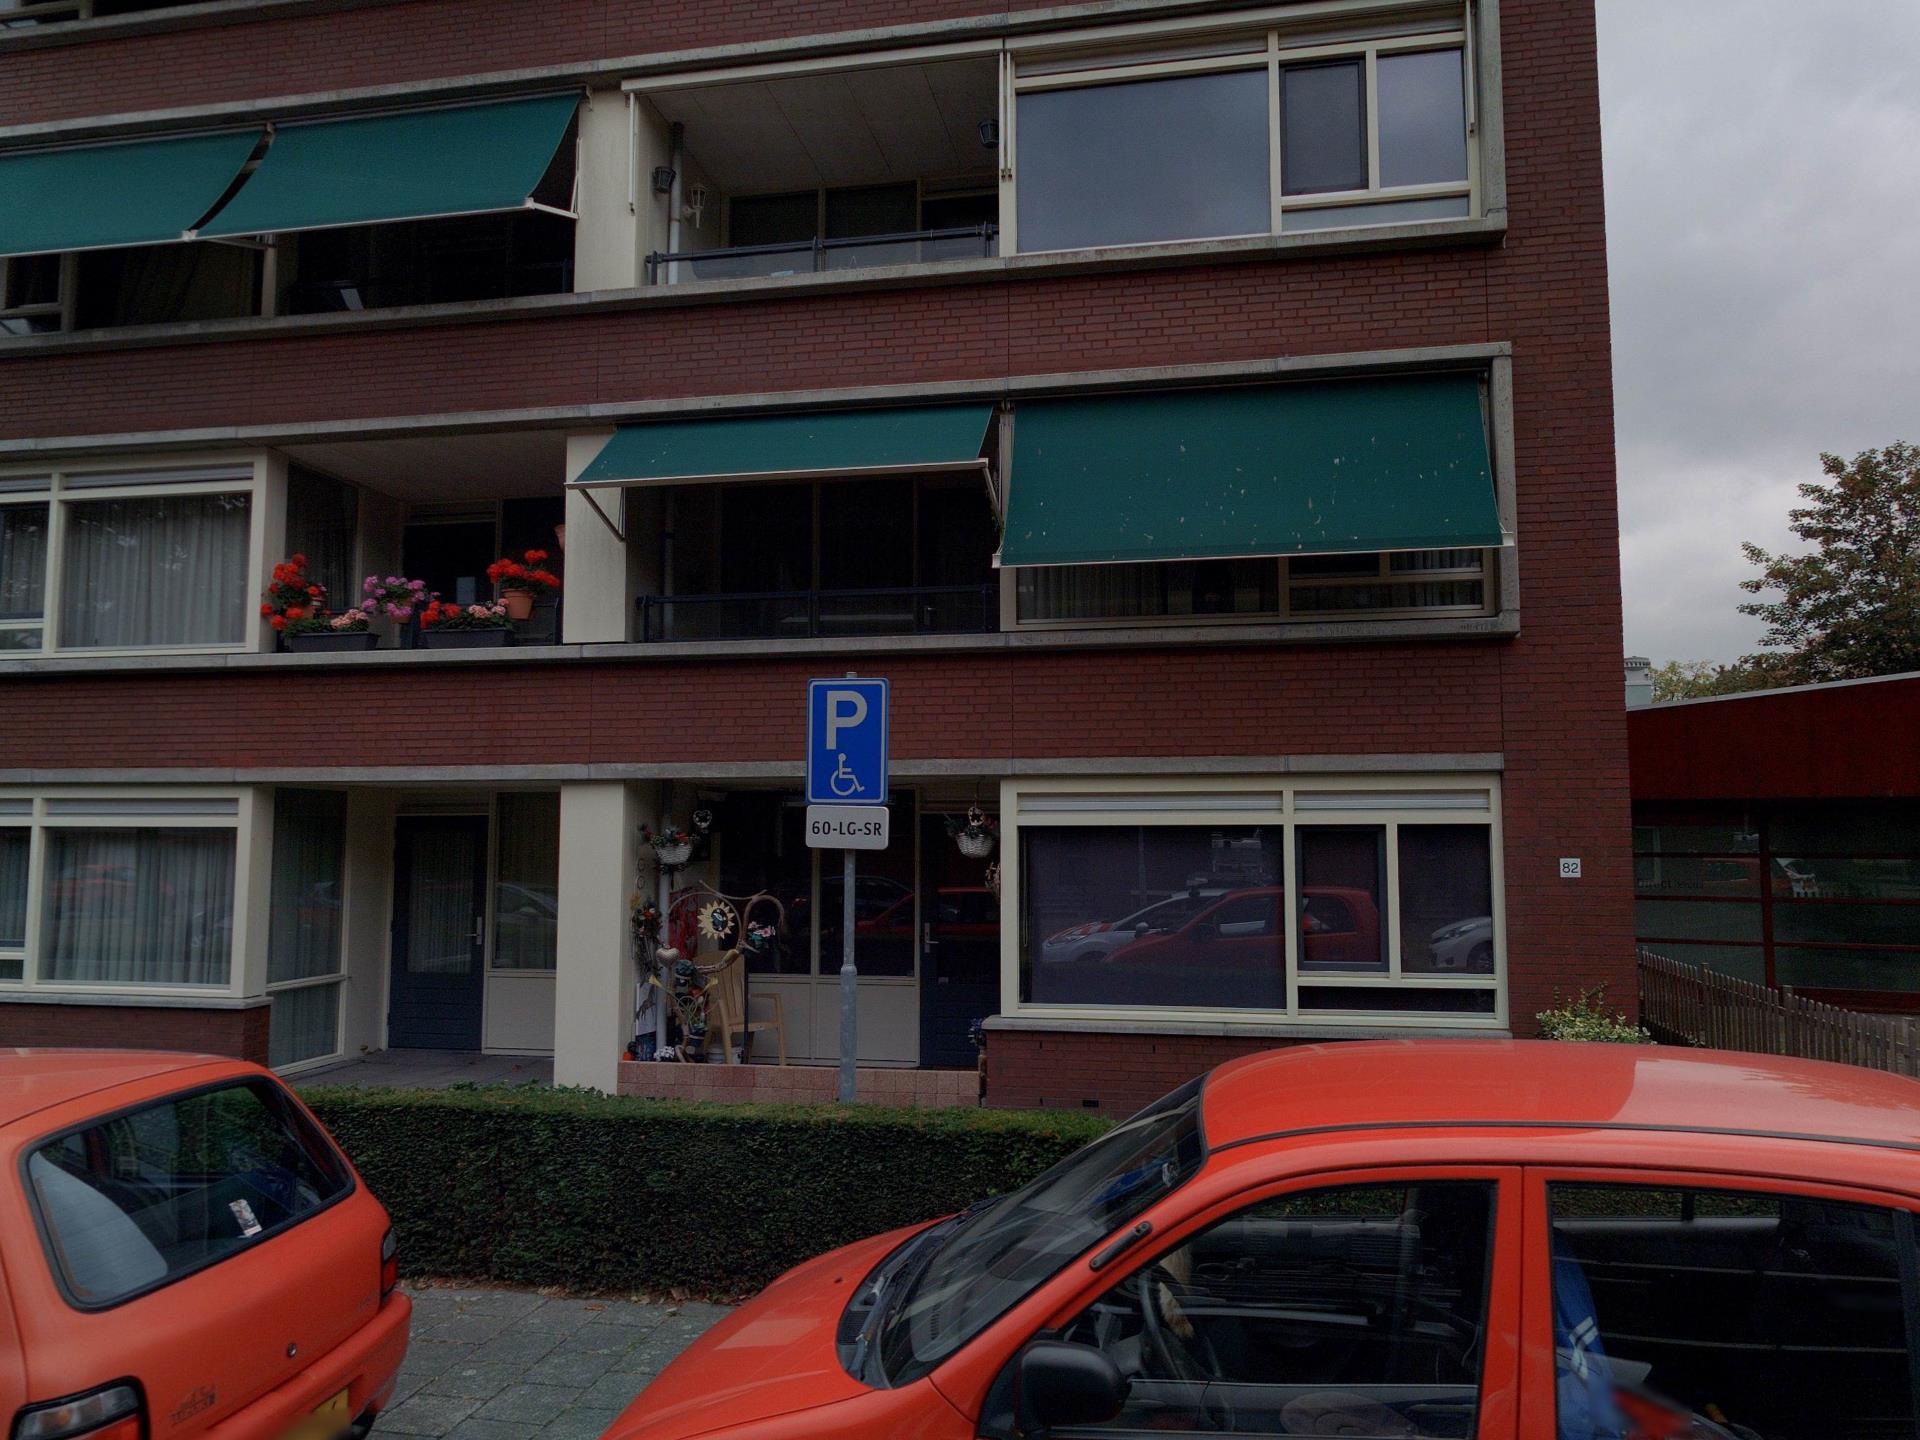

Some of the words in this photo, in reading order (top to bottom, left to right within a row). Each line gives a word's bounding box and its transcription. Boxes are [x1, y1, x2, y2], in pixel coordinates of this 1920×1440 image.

[826, 690, 868, 750] P
[811, 821, 882, 836] 60-LG-SR
[1562, 862, 1579, 874] 82
